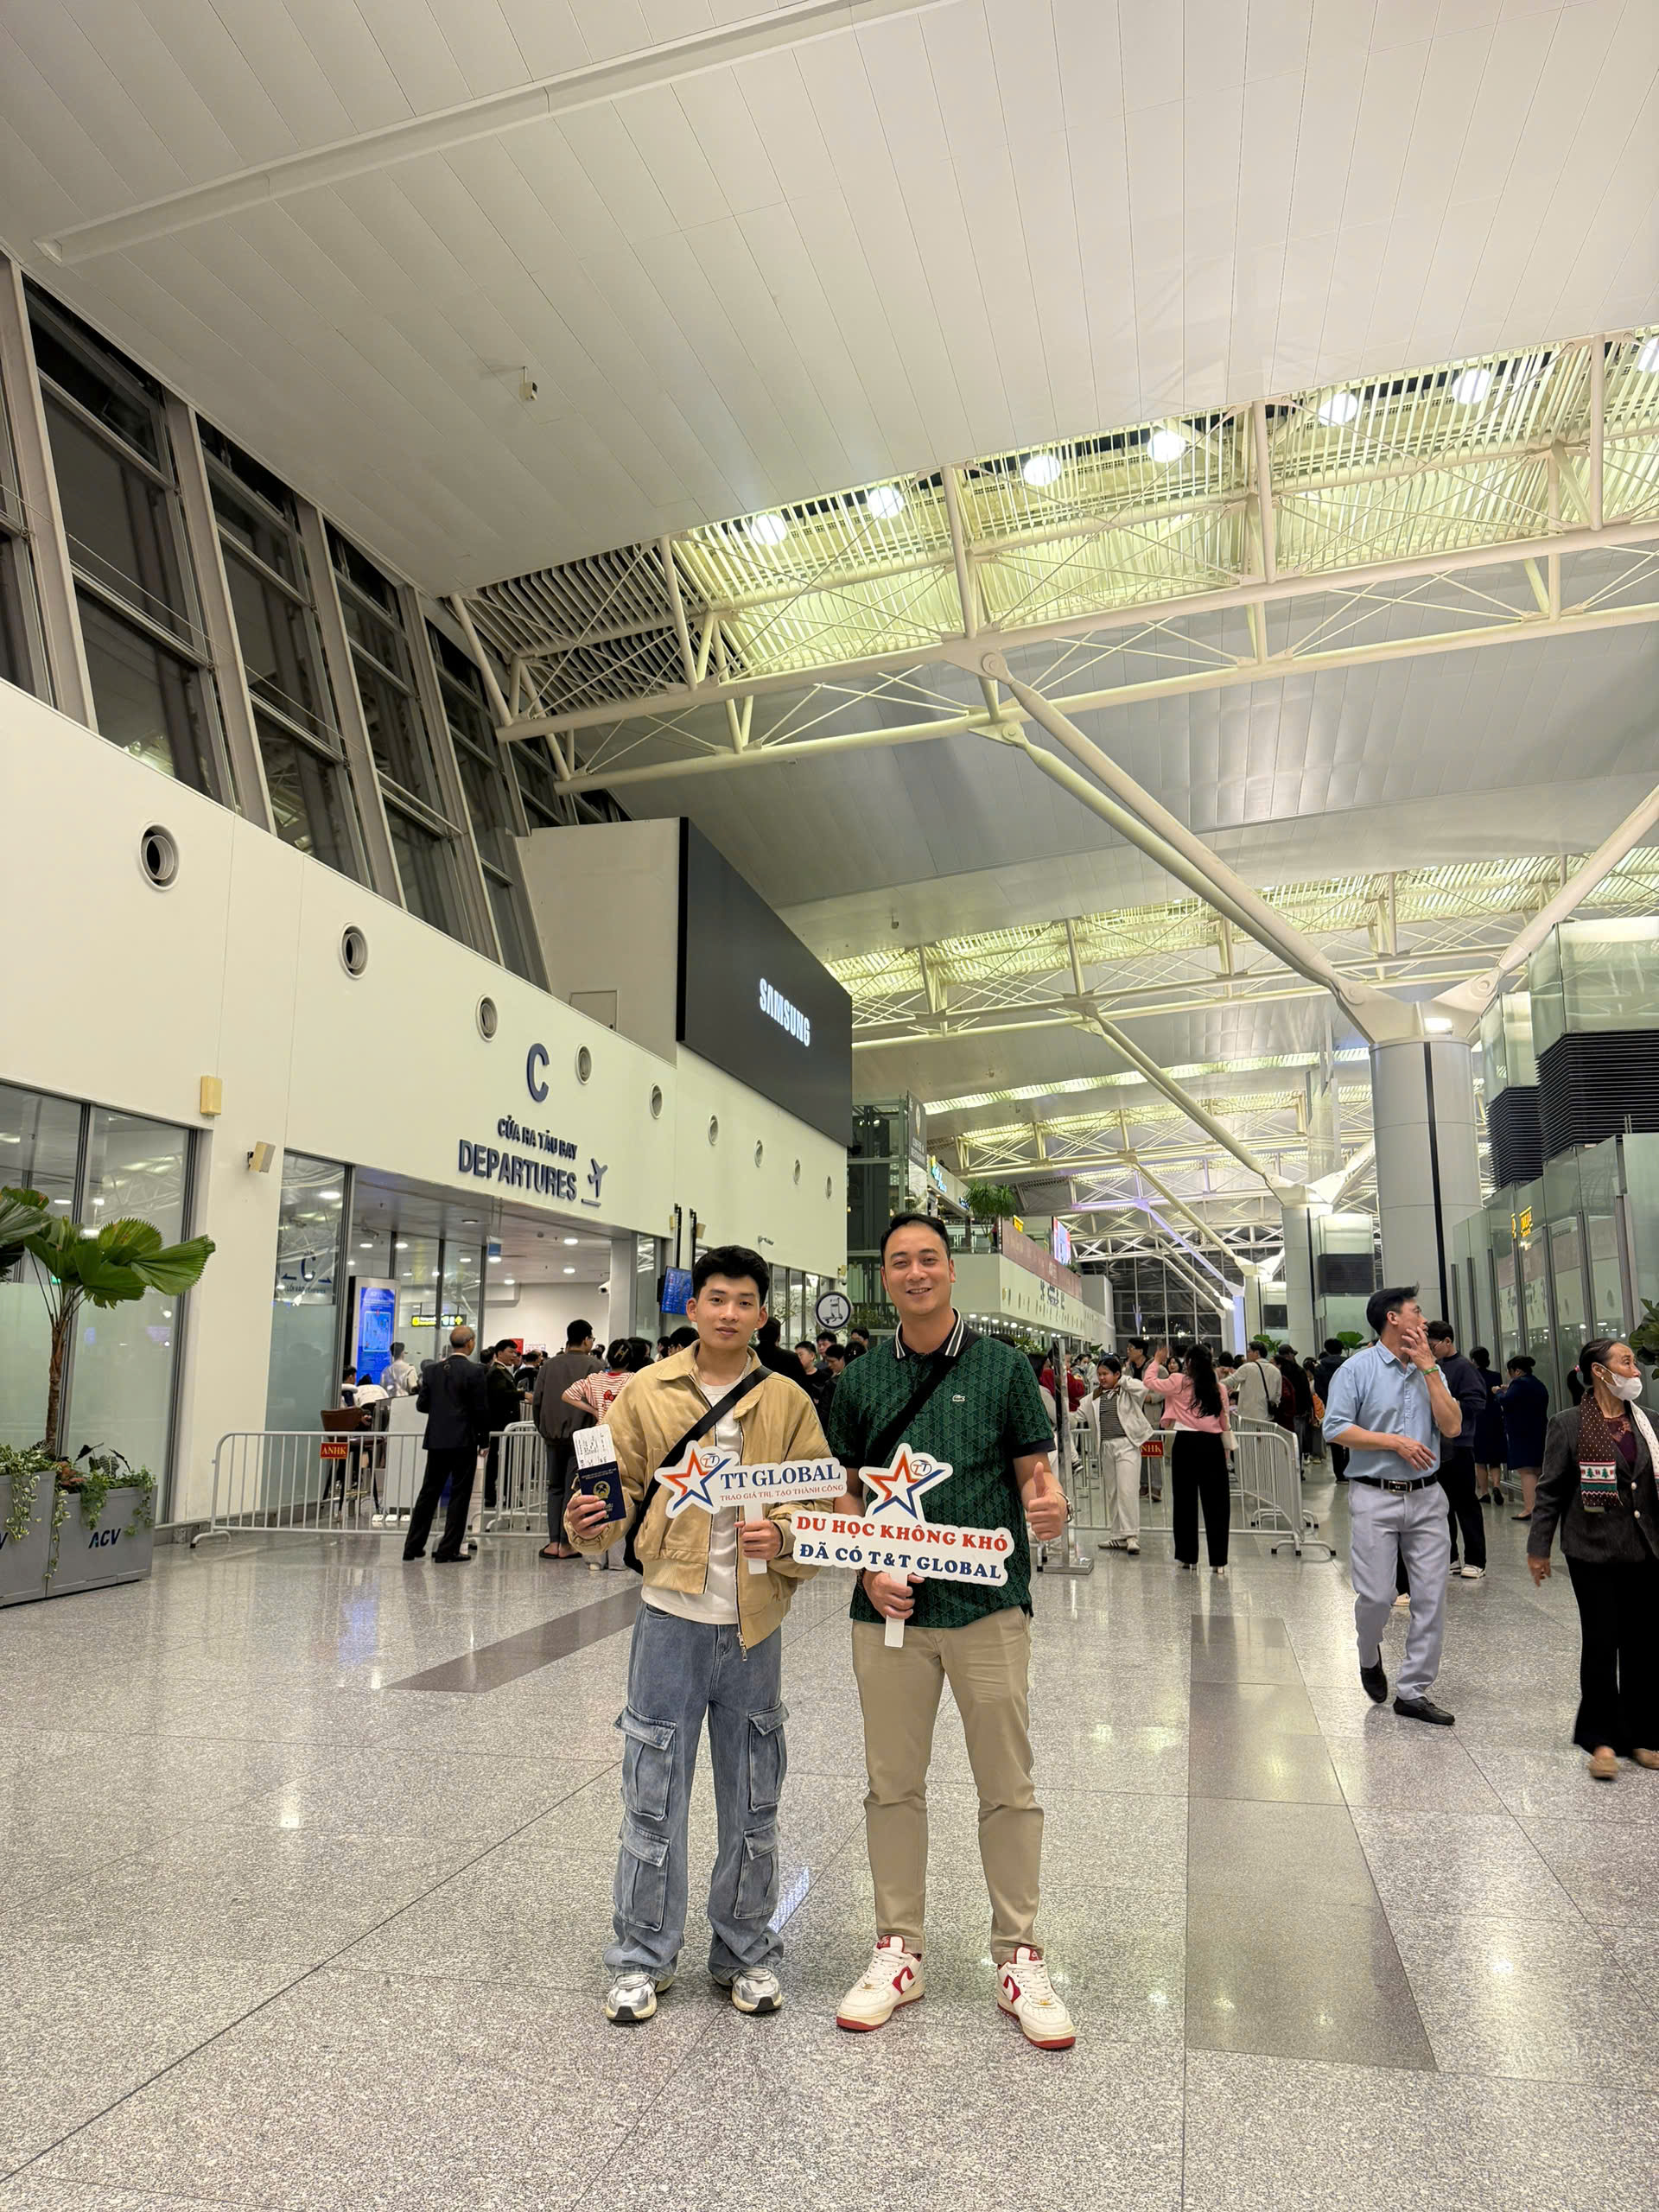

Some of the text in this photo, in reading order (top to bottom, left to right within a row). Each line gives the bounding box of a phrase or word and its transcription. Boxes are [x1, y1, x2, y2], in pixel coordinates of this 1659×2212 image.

[760, 977, 810, 1047] SAMSUNG
[526, 1043, 550, 1103] C
[522, 1127, 537, 1147] RA
[559, 1140, 578, 1160] BAY
[459, 1139, 577, 1201] DEPARTURES
[720, 1464, 841, 1490] TT GLOBAL
[792, 1486, 820, 1496] THÀNH
[822, 1484, 843, 1493] CÔNG
[88, 1528, 121, 1548] ACV
[797, 1516, 1008, 1552] DU HỌC KHÔNG KHÓ
[800, 1541, 1001, 1580] ĐÃ CÓ T&T GLOBAL
